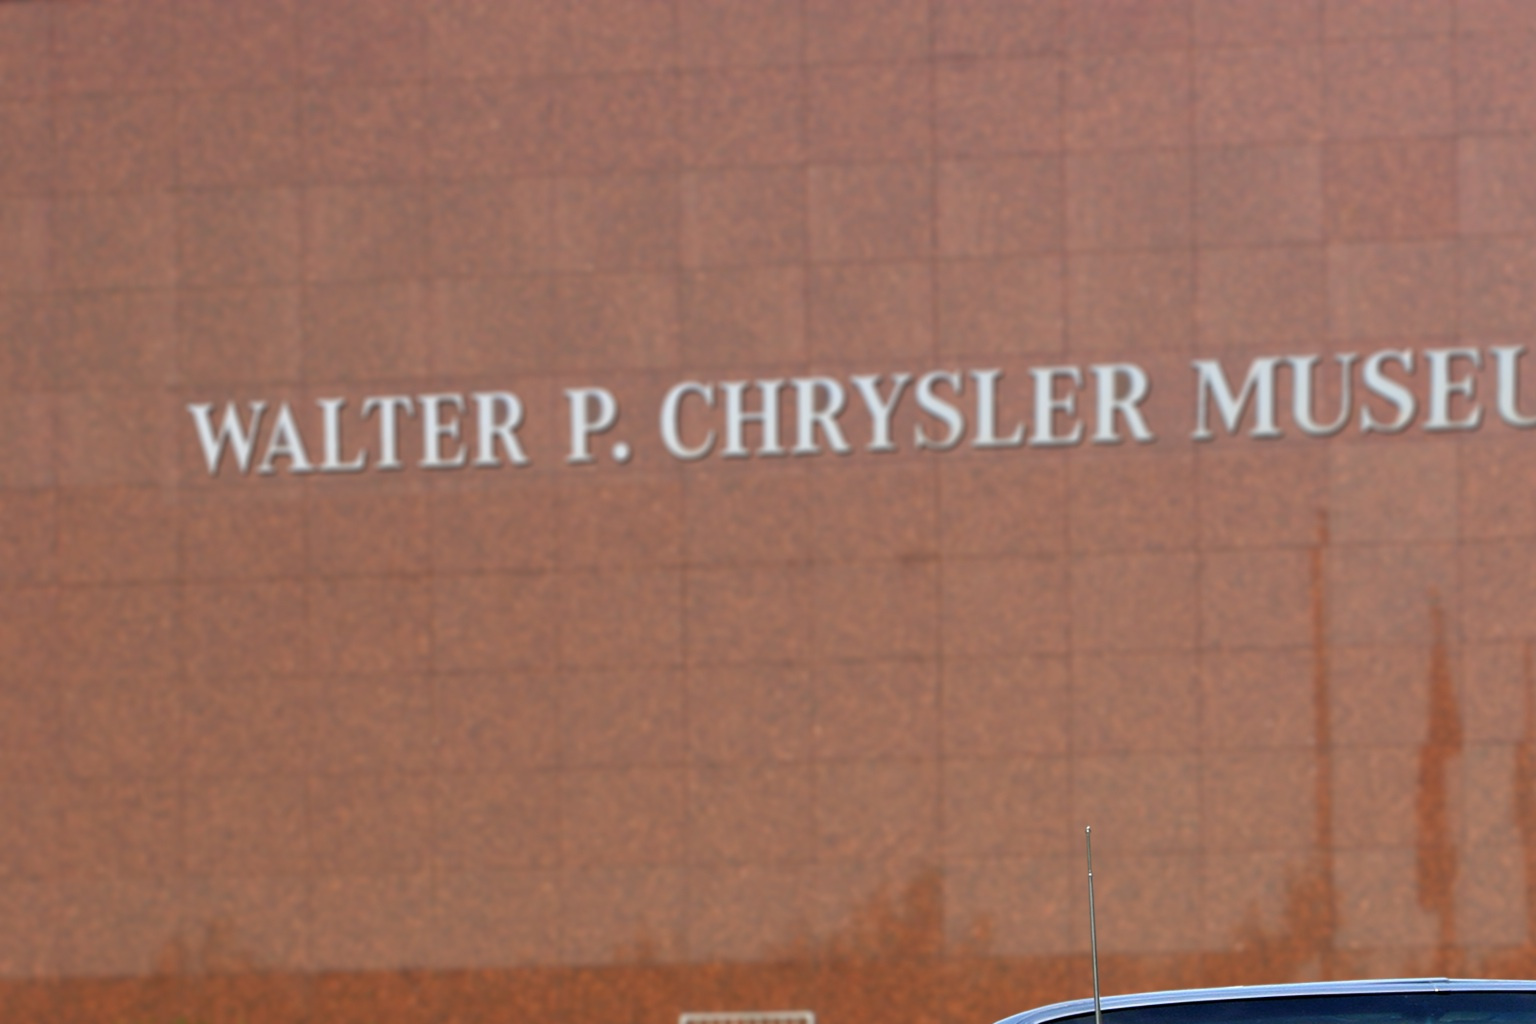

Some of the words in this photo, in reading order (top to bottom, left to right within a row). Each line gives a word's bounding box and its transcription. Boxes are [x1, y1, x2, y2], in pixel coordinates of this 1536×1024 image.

[187, 391, 530, 475] WALTER
[564, 387, 632, 464] P.
[659, 362, 1155, 459] CHRYSLER
